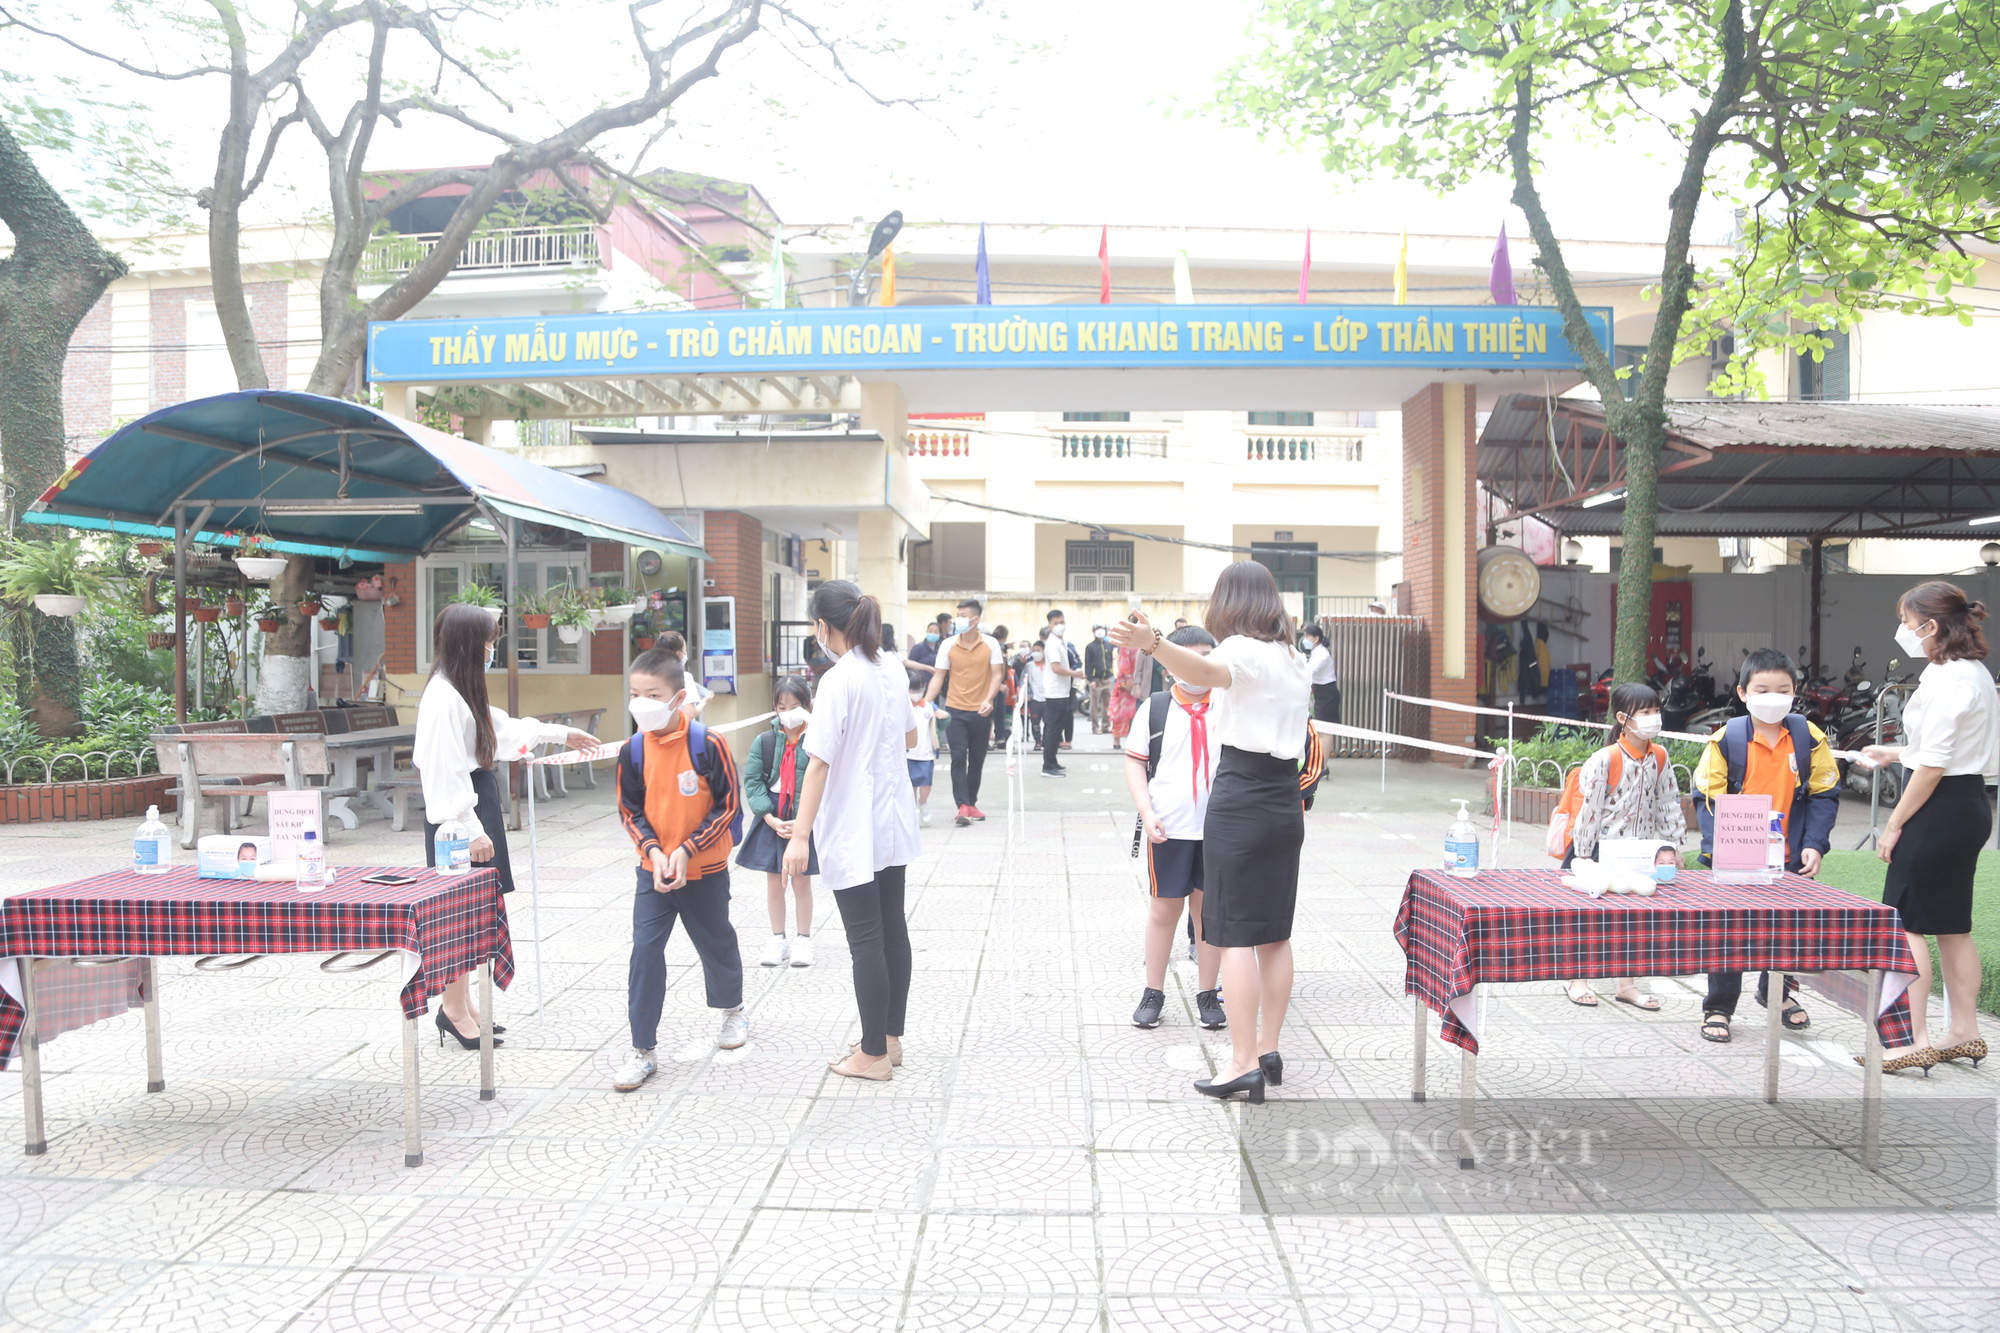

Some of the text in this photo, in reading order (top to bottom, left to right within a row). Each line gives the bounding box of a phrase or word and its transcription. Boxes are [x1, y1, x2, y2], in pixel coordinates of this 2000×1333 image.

[429, 325, 497, 366] THẦY
[504, 321, 567, 363] MẪU
[575, 327, 638, 367] MỰC
[666, 320, 719, 358] TRÒ
[728, 319, 812, 357] CHĂM
[821, 323, 922, 355] NGOAN
[951, 315, 1068, 353] TRƯỜNG
[1078, 321, 1179, 353] KHANG
[1187, 321, 1284, 353] TRANG
[1313, 315, 1368, 353] LỚP
[1377, 315, 1454, 353] THÂN
[1462, 316, 1547, 360] THIỆN
[1744, 812, 1763, 820] DỊCH
[1721, 823, 1735, 831] SÁT
